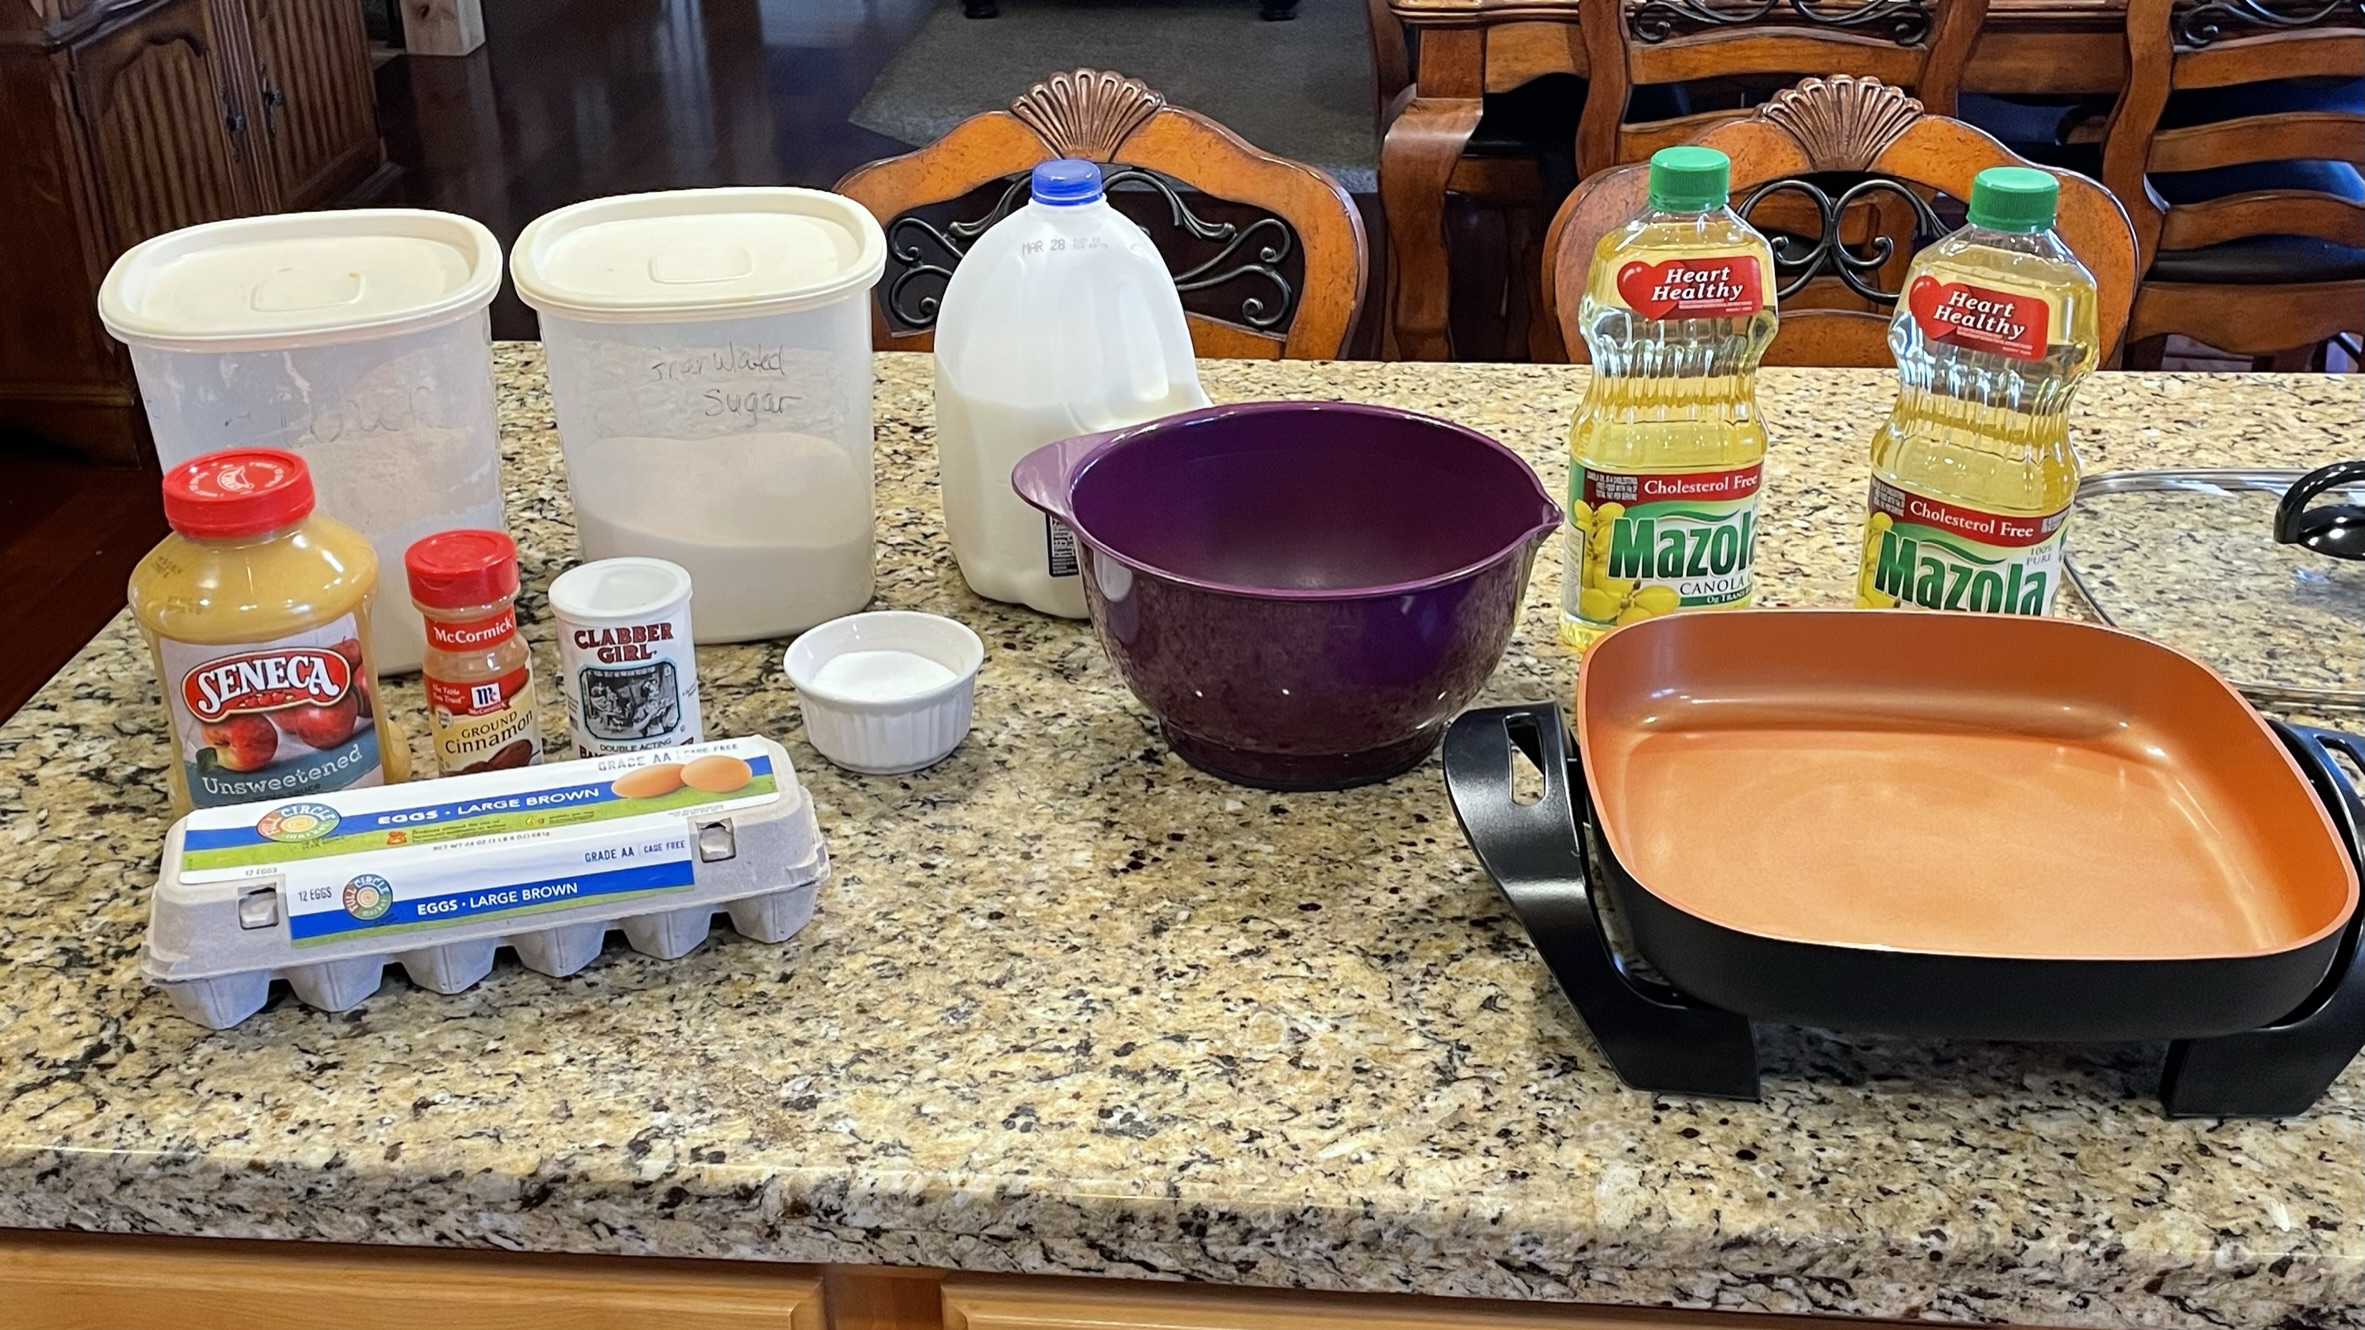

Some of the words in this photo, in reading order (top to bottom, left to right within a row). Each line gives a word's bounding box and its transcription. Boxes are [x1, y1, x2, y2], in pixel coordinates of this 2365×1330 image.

[1022, 240, 1044, 255] MAR
[1050, 239, 1065, 251] 28
[1665, 266, 1731, 284] Heart
[1651, 282, 1743, 301] Healthy
[1948, 291, 2015, 318] Heart
[1934, 304, 2025, 340] Healthy
[702, 389, 803, 428] Sugar
[1644, 477, 1729, 496] Cholesterol
[1733, 475, 1759, 489] Free
[1910, 500, 1995, 534] Cholesterol
[2000, 522, 2034, 538] Free
[1680, 576, 1745, 595] CANOLA
[1875, 529, 2047, 616] Mazola
[433, 617, 513, 644] McCormick
[574, 622, 674, 649] CLABBER
[597, 645, 654, 664] GIRL
[197, 655, 340, 714] SENECA
[445, 710, 534, 755] Cinnamon
[461, 711, 518, 739] GROUND
[600, 743, 638, 752] DOUBLE
[640, 738, 672, 751] ACTING
[653, 752, 671, 764] AA
[202, 744, 363, 796] Unsweetened
[280, 804, 336, 821] CIRCLE
[377, 810, 438, 825] EGGS
[457, 798, 521, 815] LARGE
[526, 788, 599, 806] BROWN
[585, 849, 617, 863] GRADE
[621, 846, 634, 857] AA
[643, 843, 663, 853] CAGE
[666, 839, 686, 850] FREE
[298, 890, 308, 902] 12
[310, 886, 333, 900] EGGS
[354, 875, 390, 895] CIRCLE
[417, 899, 458, 916] EGGS
[470, 890, 518, 909] LARGE
[522, 882, 578, 901] BROWN
